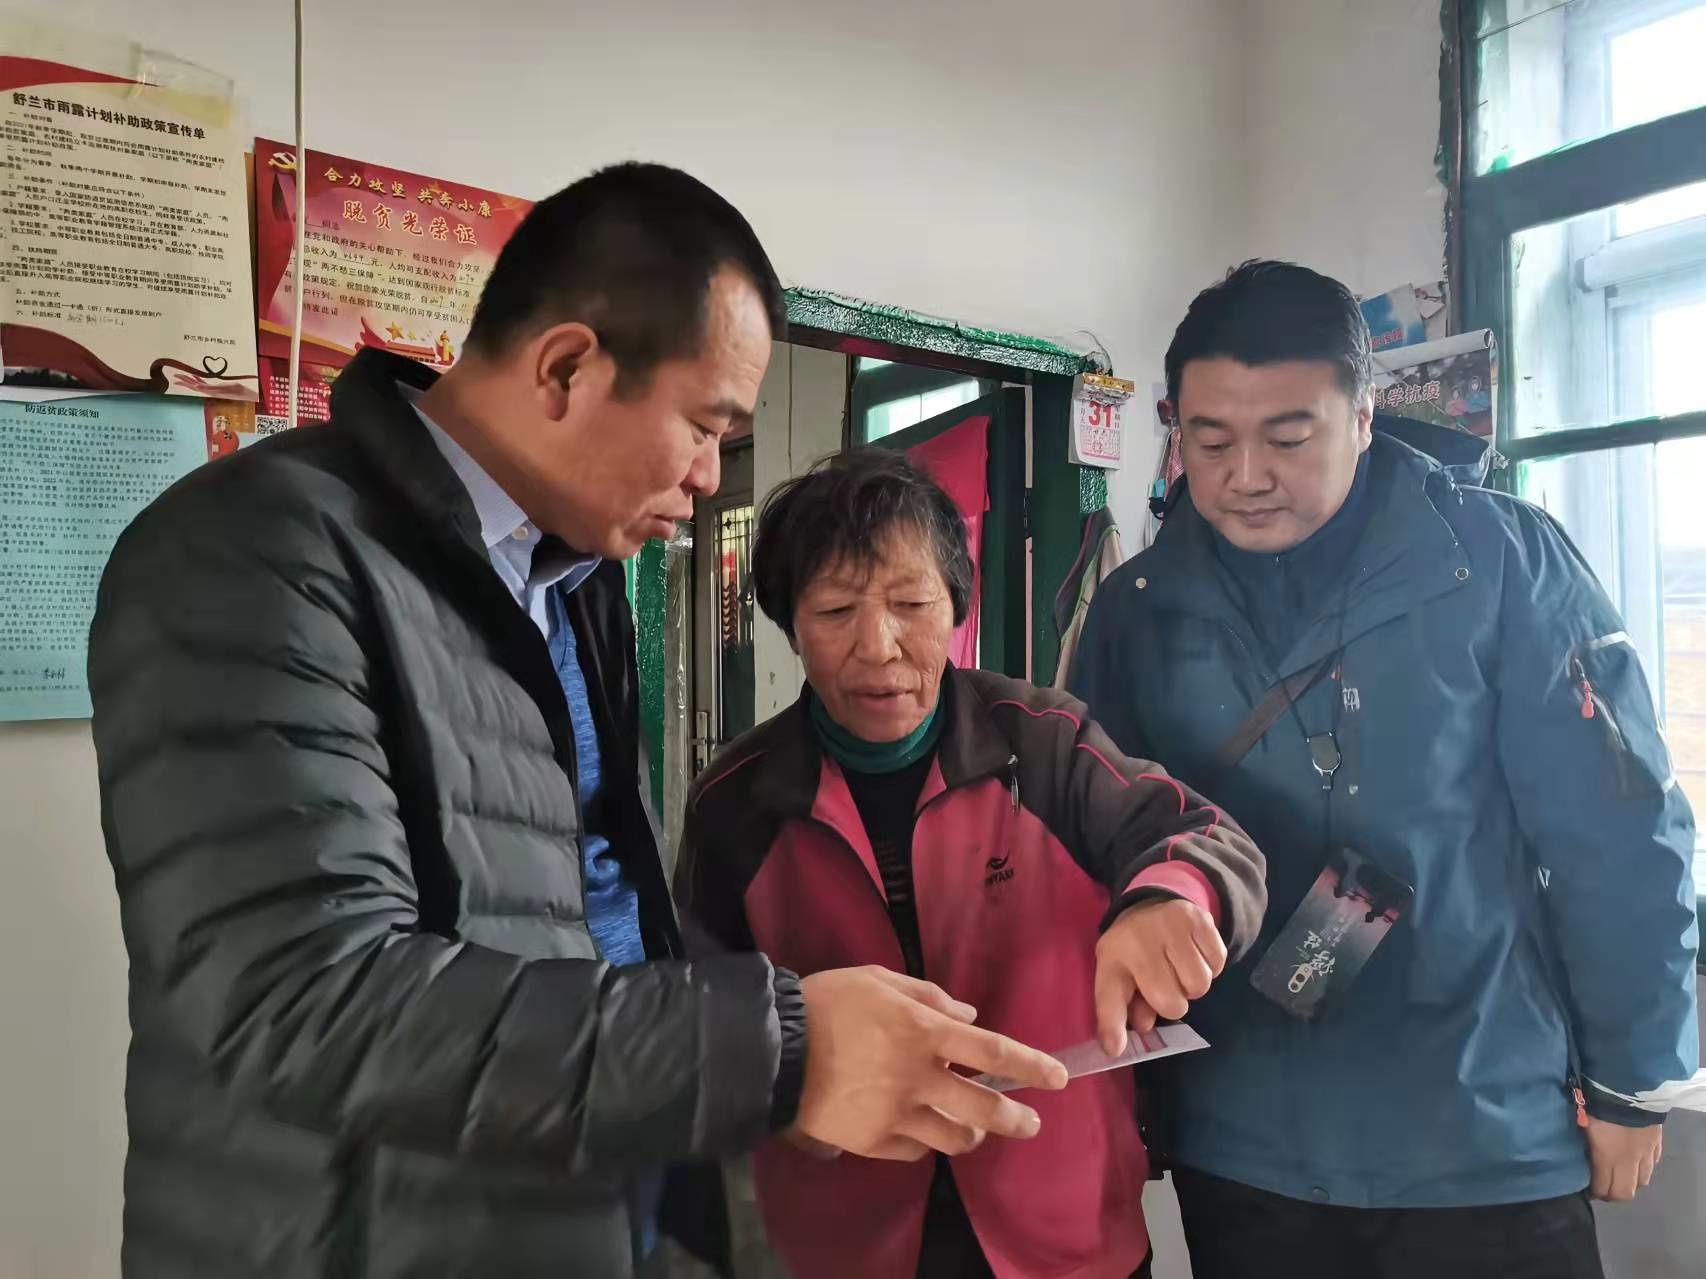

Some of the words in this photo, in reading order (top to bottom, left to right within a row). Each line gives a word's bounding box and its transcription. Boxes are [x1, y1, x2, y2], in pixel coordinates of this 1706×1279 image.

[12, 92, 205, 140] 舒兰市雨露计划补助政策宣传单
[324, 167, 407, 199] 合力攻坚
[418, 188, 492, 218] 共奔小康
[343, 200, 478, 246] 脱贫光荣证
[25, 403, 100, 418] 防返贫政策须知
[1088, 400, 1112, 428] 31
